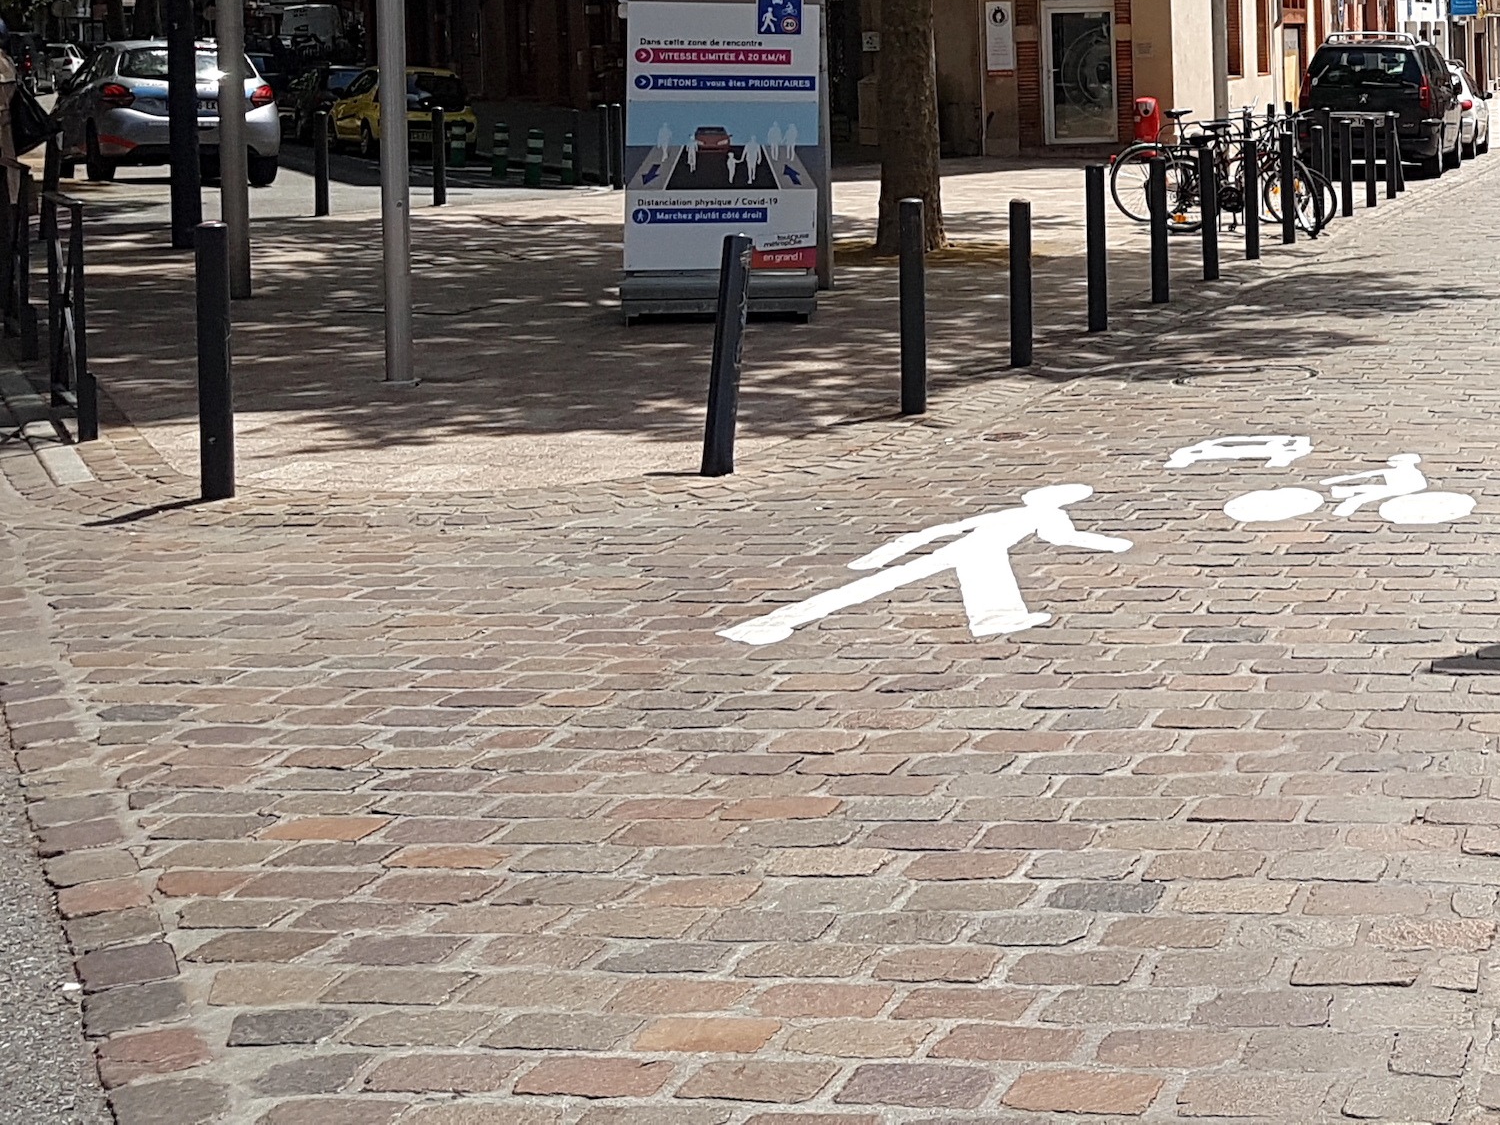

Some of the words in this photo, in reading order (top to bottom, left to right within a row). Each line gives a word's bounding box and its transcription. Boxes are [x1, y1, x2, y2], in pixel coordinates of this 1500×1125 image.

[639, 38, 661, 46] Dans
[710, 38, 720, 47] de
[722, 40, 762, 48] rencontre
[658, 51, 698, 61] VITESSE
[700, 50, 735, 62] LIMITÉE
[747, 52, 759, 62] 20
[761, 53, 787, 62] KM/H
[657, 77, 697, 87] PIÉTONS
[706, 80, 726, 88] vous
[728, 78, 746, 88] êtes
[748, 78, 811, 89] PRIORITAIRES
[637, 198, 693, 207] Distanciation
[695, 197, 732, 208] physique
[741, 197, 778, 206] Covid-19
[656, 211, 693, 220] Marchez
[695, 211, 719, 221] plutôt
[721, 211, 740, 220] côté
[742, 211, 762, 220] droit
[762, 254, 774, 262] en
